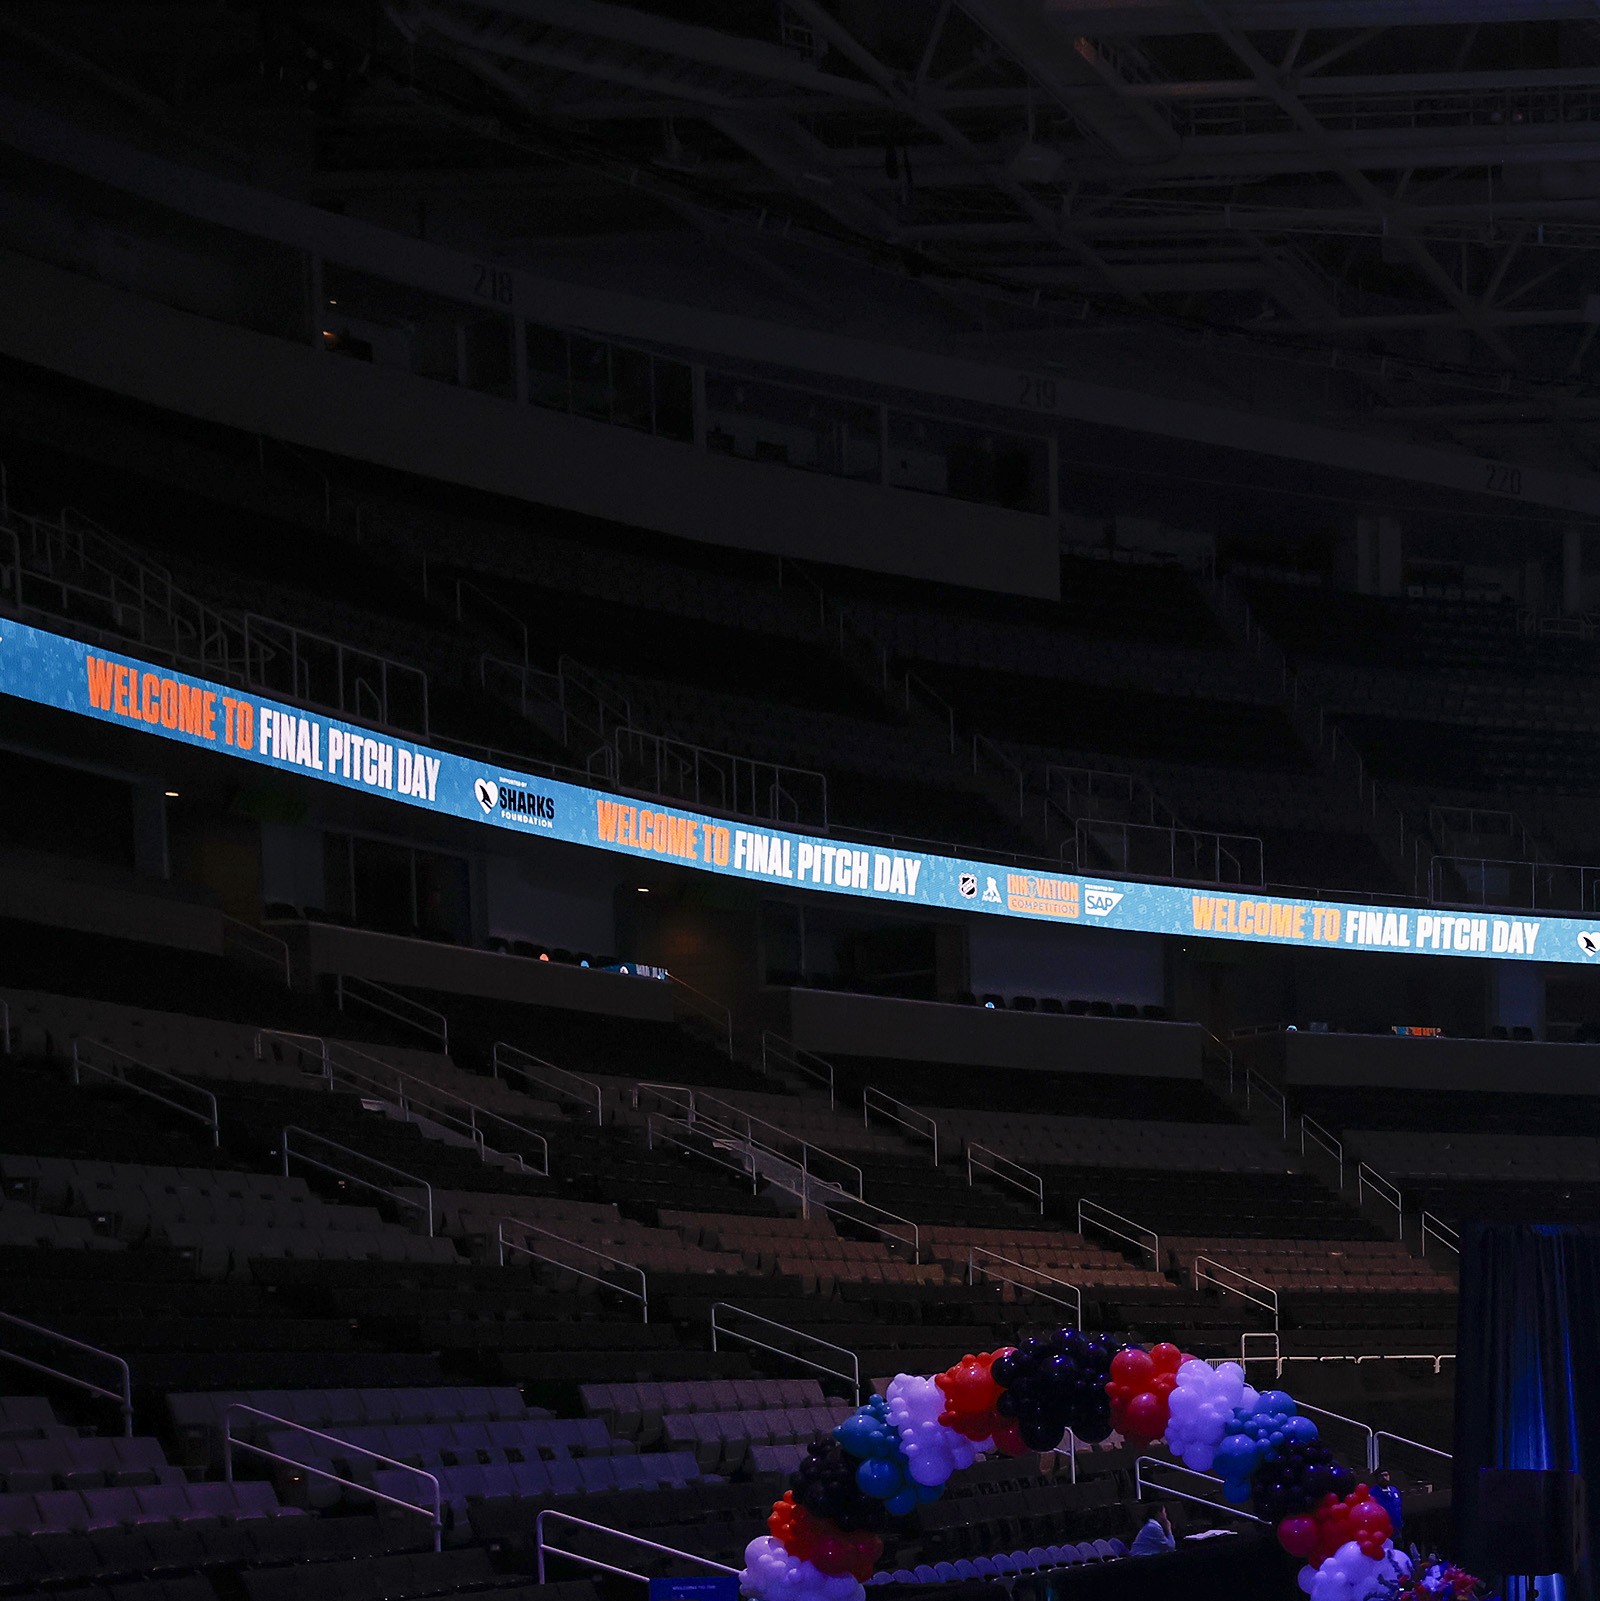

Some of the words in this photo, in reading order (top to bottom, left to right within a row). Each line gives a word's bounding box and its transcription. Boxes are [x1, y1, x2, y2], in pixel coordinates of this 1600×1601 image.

[86, 655, 217, 741] WELCOME
[223, 695, 255, 751] TO
[259, 706, 324, 771] FINAL
[328, 726, 394, 791] PITCH
[397, 750, 442, 803] DAY
[500, 786, 555, 820] SHARKS
[501, 810, 553, 829] FOUNDATION
[596, 799, 699, 859] WELCOME
[701, 823, 731, 867] TO
[733, 830, 794, 879] FINAL
[797, 842, 869, 890] PITCH
[873, 854, 923, 897] DAY
[1011, 898, 1075, 915] COMPETITION
[1086, 895, 1114, 912] SAP
[1191, 894, 1306, 940] WELCOME
[1310, 906, 1342, 943] TO
[1345, 909, 1411, 948] FINAL
[1416, 915, 1488, 953] PITCH
[1491, 919, 1541, 956] DAY
